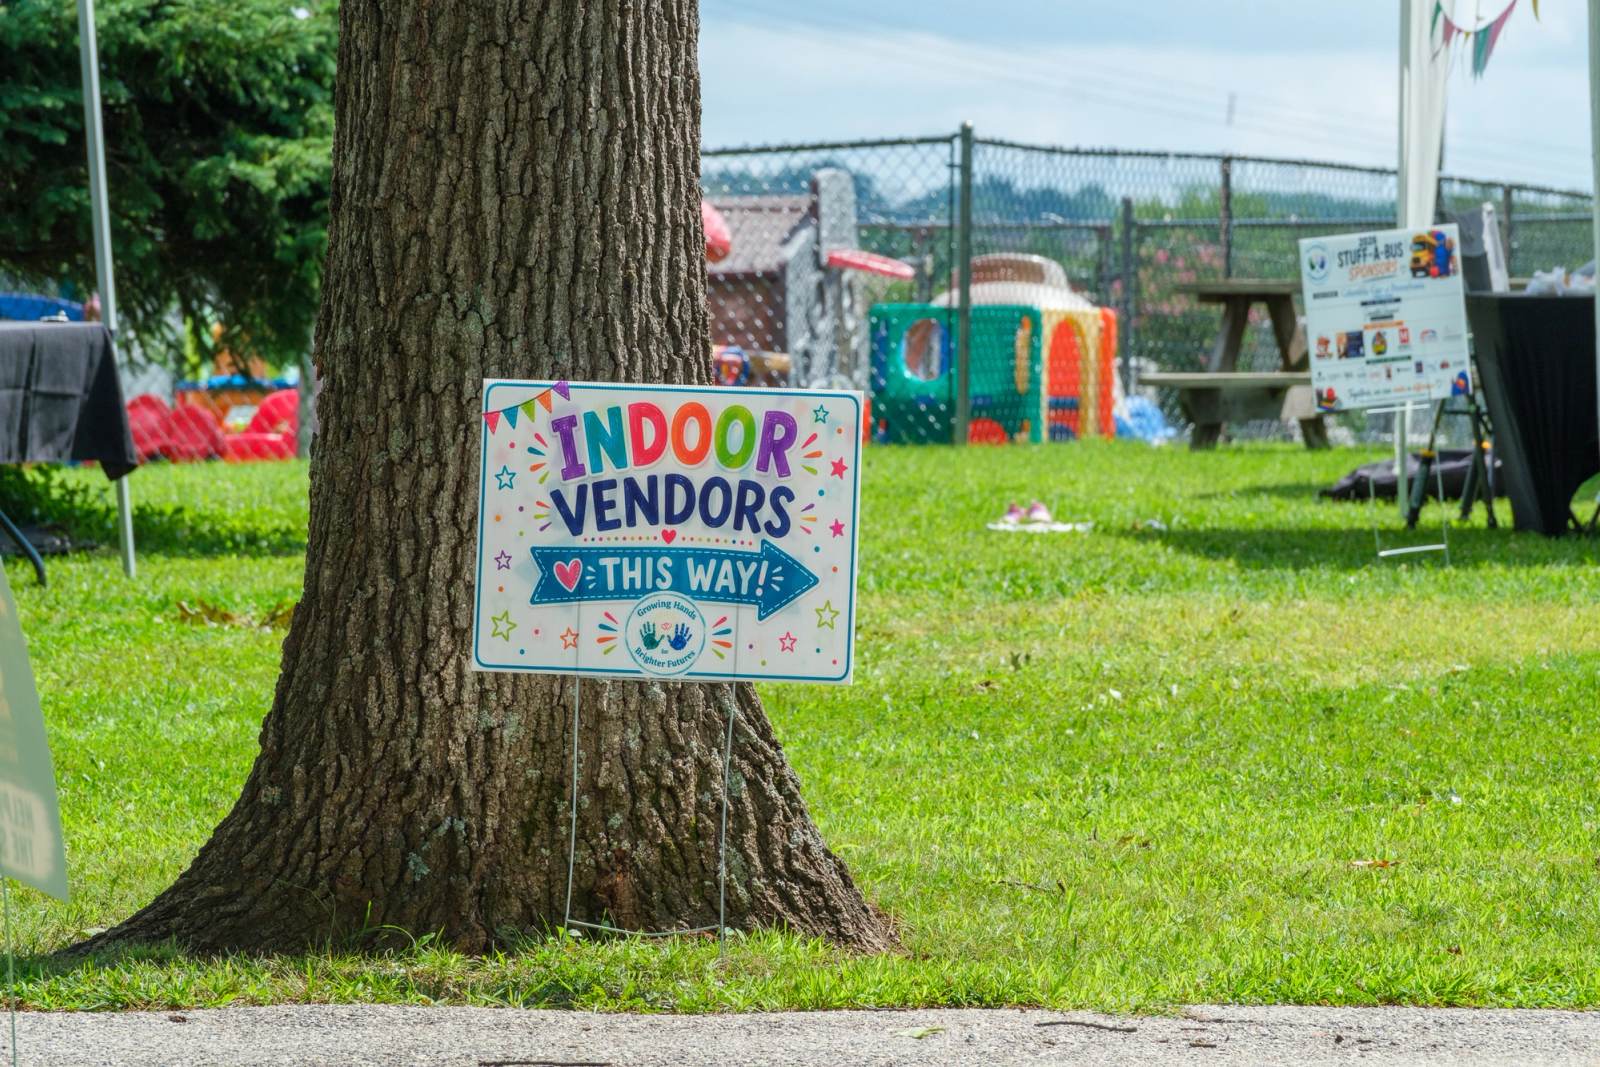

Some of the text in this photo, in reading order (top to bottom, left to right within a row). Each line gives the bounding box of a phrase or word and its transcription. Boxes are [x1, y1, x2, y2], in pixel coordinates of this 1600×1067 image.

[1337, 241, 1404, 267] STUFF-A-BUS
[1349, 260, 1398, 280] SPONSORS
[551, 402, 798, 481] INDOOR
[550, 473, 795, 538] VENDORS
[599, 557, 769, 597] THIS WAY!
[637, 600, 696, 620] Growing Hands
[635, 647, 696, 668] Brighter Futures
